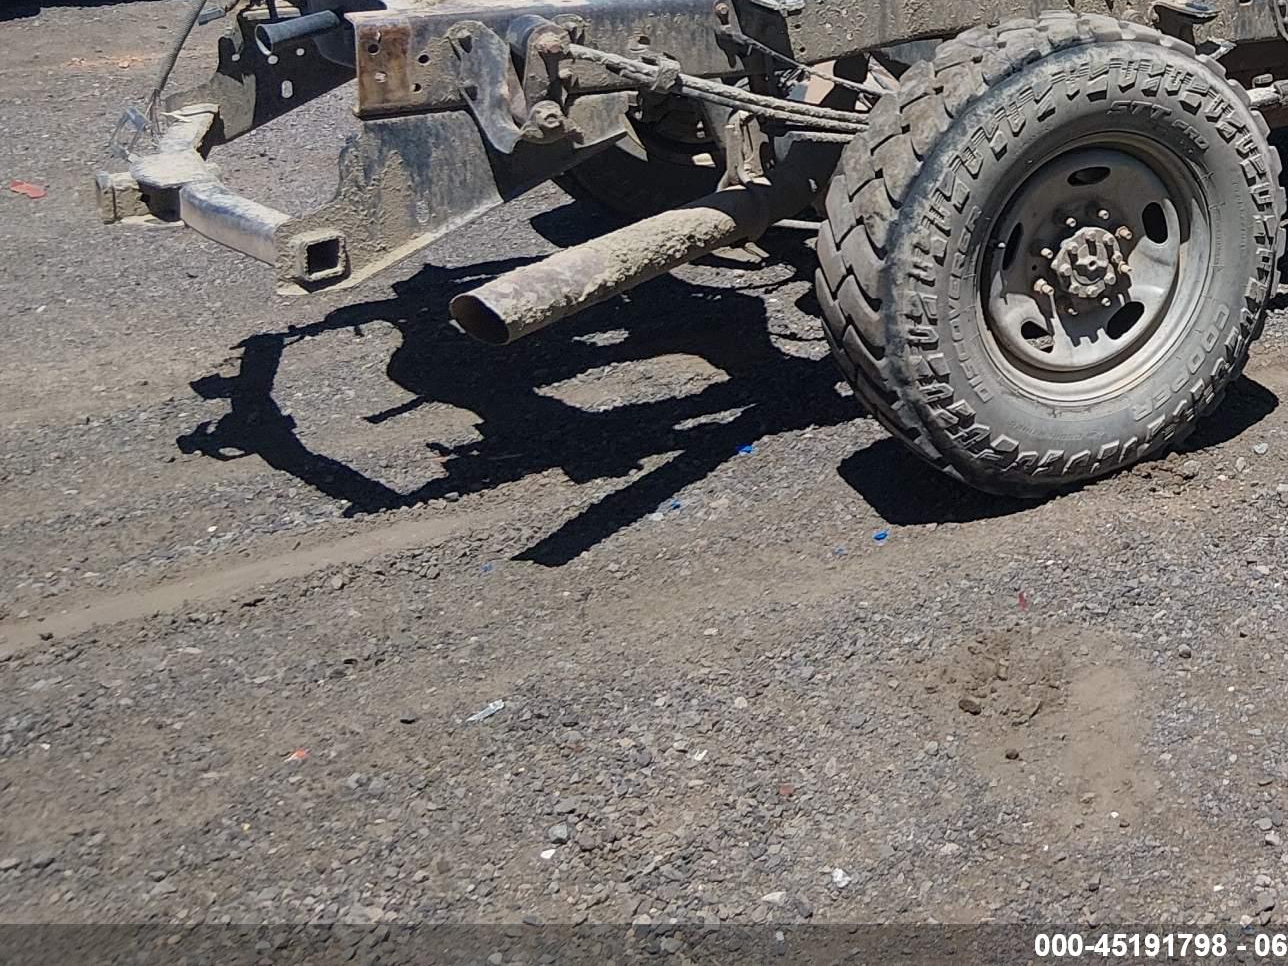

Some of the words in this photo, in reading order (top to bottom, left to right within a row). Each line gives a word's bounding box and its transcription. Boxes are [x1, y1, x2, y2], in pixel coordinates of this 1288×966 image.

[1106, 100, 1173, 119] STT
[1171, 118, 1209, 152] PRO
[948, 205, 993, 403] DISCOVERER
[1133, 304, 1230, 421] COOPER
